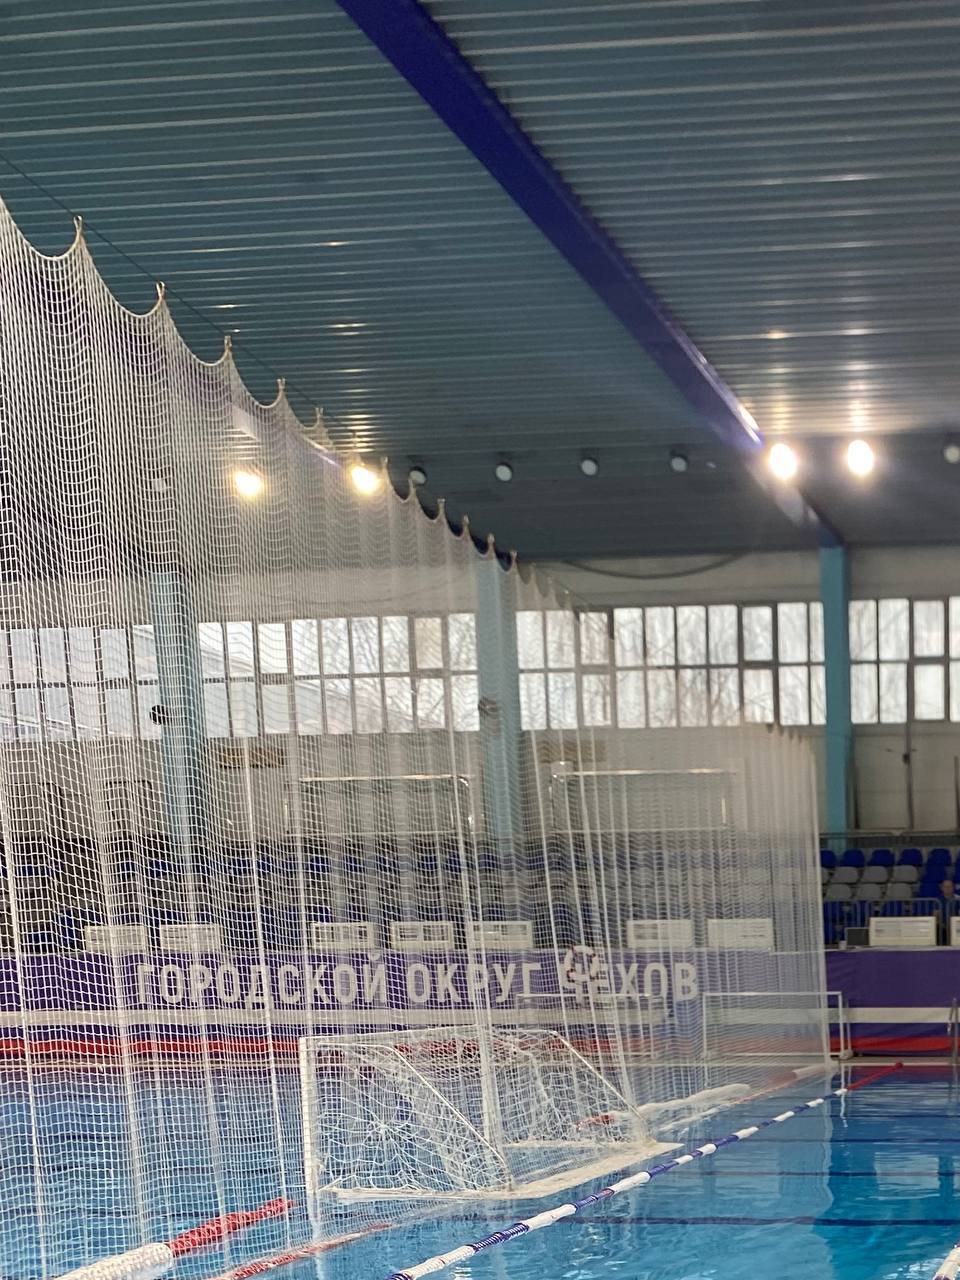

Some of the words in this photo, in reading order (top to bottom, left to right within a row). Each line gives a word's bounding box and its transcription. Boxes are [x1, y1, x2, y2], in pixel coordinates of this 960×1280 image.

[137, 951, 386, 1008] ГОРОДСКОЙ
[406, 962, 542, 1004] ОКРУГ
[560, 962, 698, 1004] ЧЕХОВ
